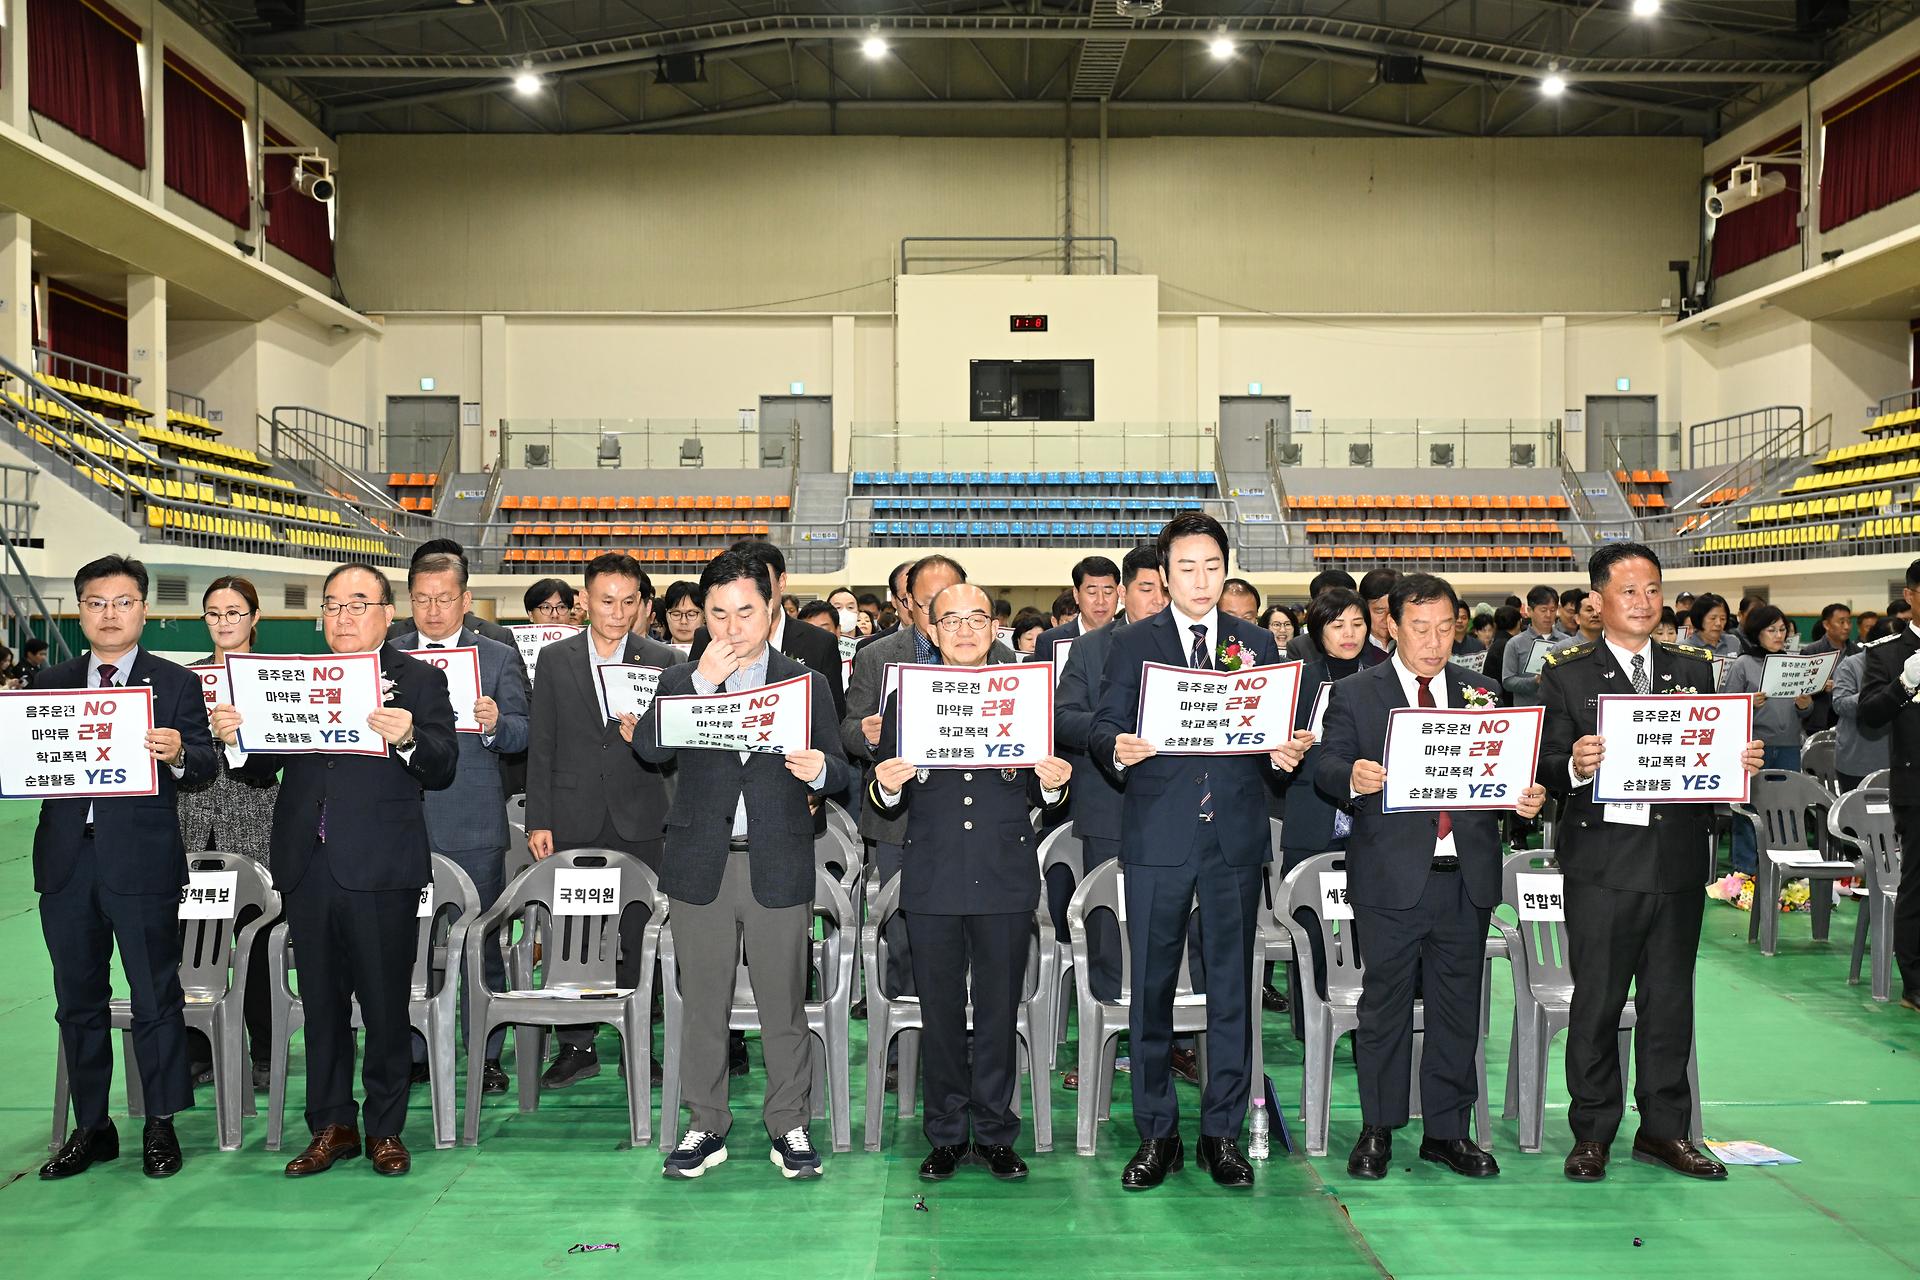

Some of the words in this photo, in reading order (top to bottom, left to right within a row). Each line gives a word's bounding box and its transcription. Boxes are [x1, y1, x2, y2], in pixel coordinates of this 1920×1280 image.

[516, 634, 537, 642] 주운전
[543, 631, 562, 641] NO
[1809, 659, 1823, 667] NO
[258, 668, 305, 682] 음주운전
[313, 667, 344, 681] NO
[627, 672, 658, 682] 음주운
[634, 684, 653, 694] 마약
[932, 681, 980, 694] 음주운전
[988, 676, 1020, 692] NO
[1177, 681, 1228, 694] 음주운전
[1234, 677, 1267, 691] NO
[202, 690, 216, 702] 절
[266, 691, 301, 703] 마약류
[309, 688, 341, 704] 근절
[692, 703, 741, 714] 음주운전
[749, 694, 779, 710] NO
[1180, 700, 1218, 712] 마약류
[1226, 696, 1261, 710] 근절
[26, 705, 75, 718] 음주운전
[84, 701, 117, 716] NO
[937, 704, 973, 716] 마약류
[981, 698, 1015, 717] 근절
[1632, 710, 1681, 723] 음주운전
[1688, 706, 1720, 722] NO
[272, 712, 320, 724] 학교폭력
[328, 710, 342, 723] X
[696, 720, 733, 728] 마약류
[742, 712, 775, 729] 근절
[1181, 718, 1230, 729] 학교폭력
[1237, 715, 1256, 727] X
[32, 729, 69, 740] 마약류
[78, 723, 112, 740] 근절
[939, 726, 988, 738] 학교폭력
[996, 722, 1012, 737] X
[1422, 722, 1471, 735] 음주운전
[1478, 720, 1509, 734] NO
[265, 732, 312, 744] 순찰활동
[320, 730, 360, 742] YES
[756, 730, 772, 742] X
[1165, 737, 1214, 746] 순찰활동
[1225, 732, 1266, 745] YES
[1637, 733, 1673, 745] 마약류
[1680, 728, 1715, 745] 근절
[36, 751, 87, 763] 학교폭력
[96, 747, 111, 761] X
[926, 747, 974, 758] 순찰활동
[984, 743, 1025, 758] YES
[1425, 744, 1461, 756] 마약류
[1469, 740, 1503, 757] 근절
[1638, 756, 1686, 768] 학교폭력
[1693, 752, 1710, 768] X
[25, 774, 75, 787] 순찰활동
[85, 768, 126, 784] YES
[1425, 766, 1473, 778] 학교폭력
[1480, 763, 1498, 776] X
[1623, 778, 1671, 791] 순찰활동
[1681, 774, 1721, 790] YES
[1409, 787, 1458, 799] 순찰활동
[1468, 784, 1508, 798] YES
[180, 888, 229, 904] 정책특보
[560, 888, 614, 904] 국회의원
[1523, 893, 1562, 909] 연합회
